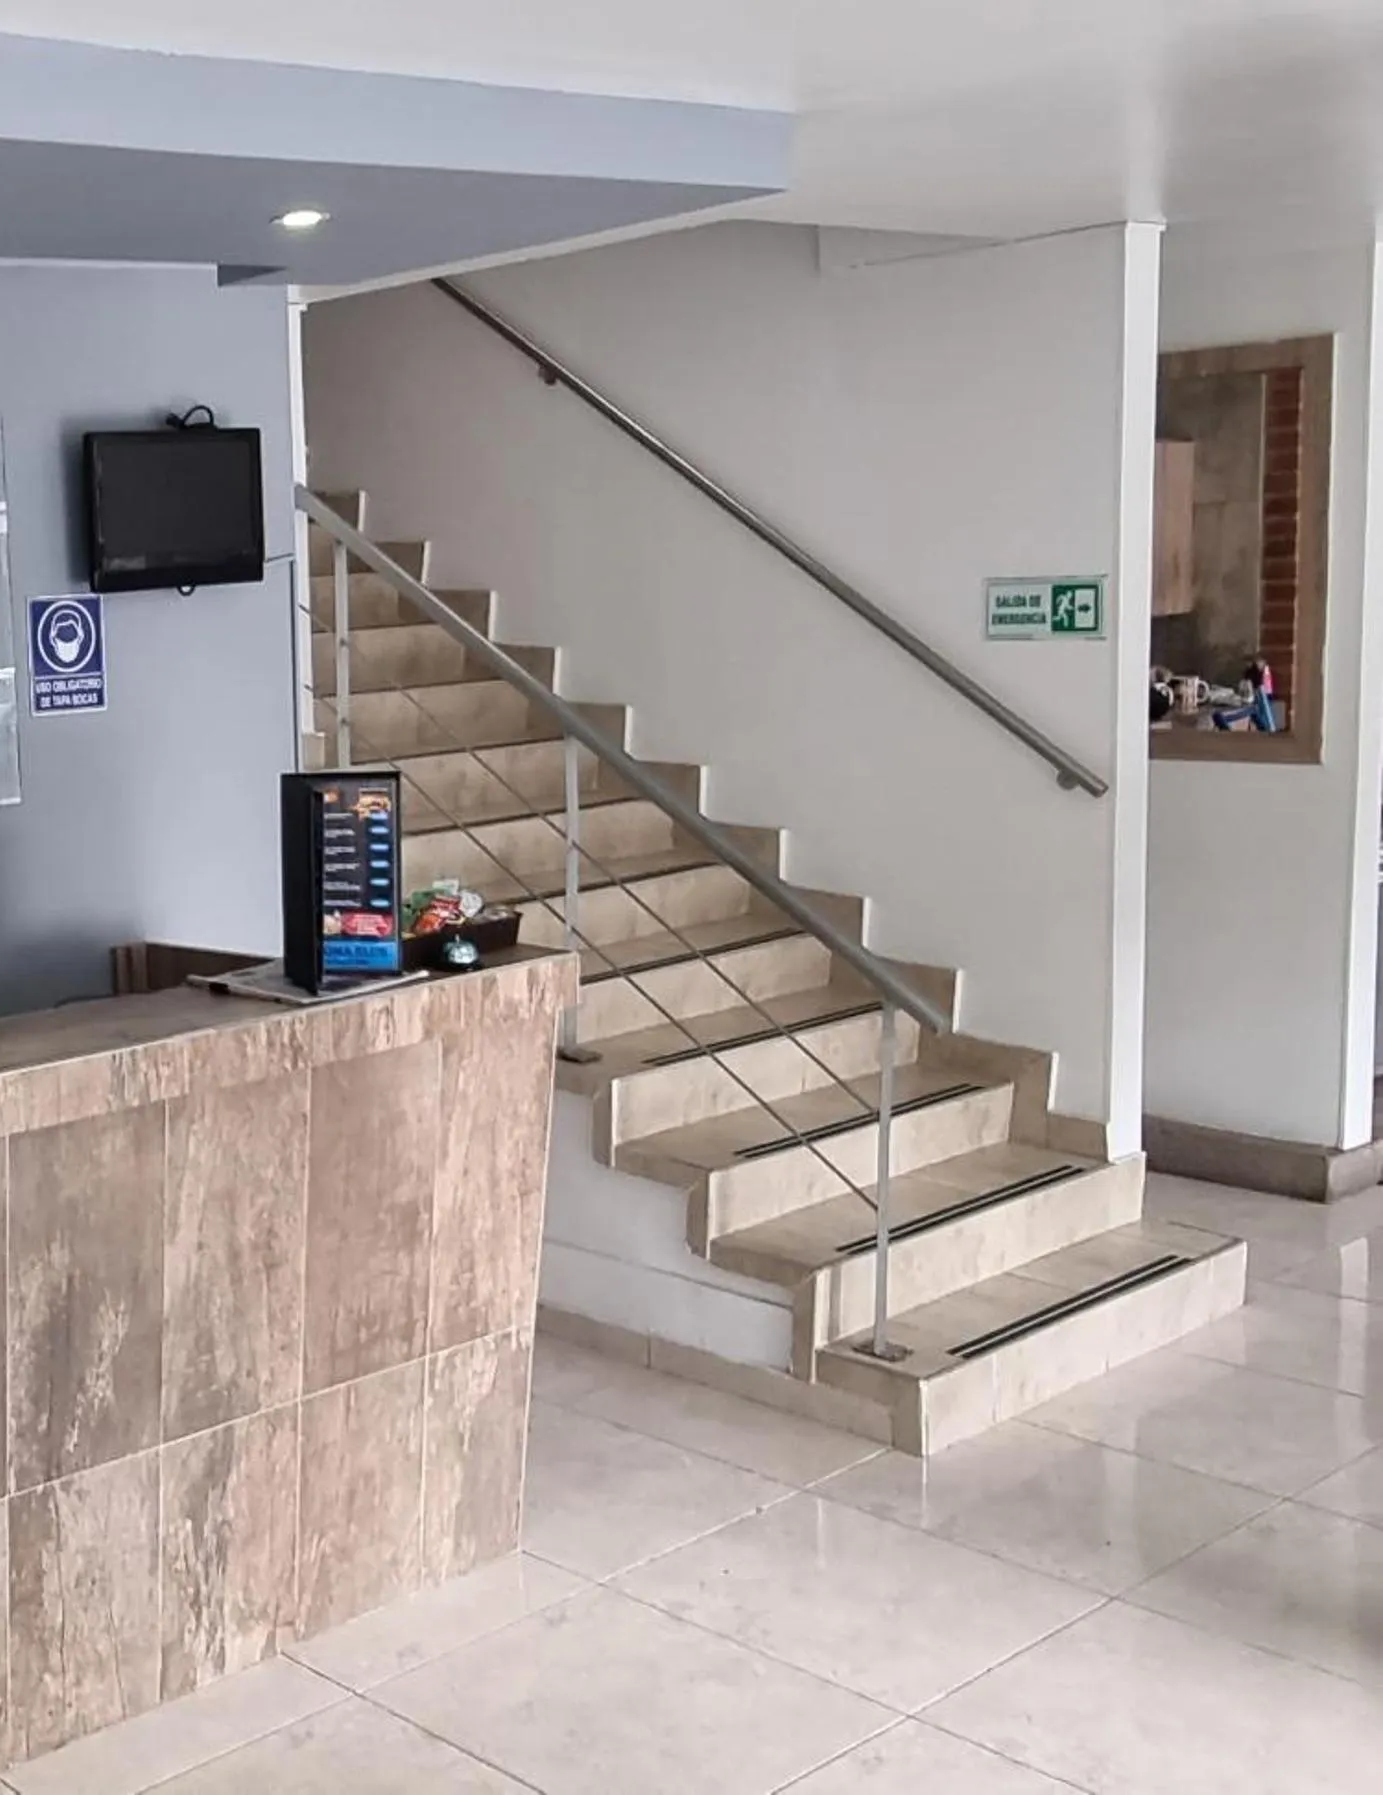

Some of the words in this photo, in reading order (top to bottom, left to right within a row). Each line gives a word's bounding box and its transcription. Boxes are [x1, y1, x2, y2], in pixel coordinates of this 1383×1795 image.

[1028, 595, 1041, 607] DE
[36, 681, 52, 694] USO
[53, 678, 102, 692] OBLIGATORIO
[40, 696, 52, 708] DE
[53, 694, 71, 706] TAPA
[72, 692, 98, 705] BOCAS
